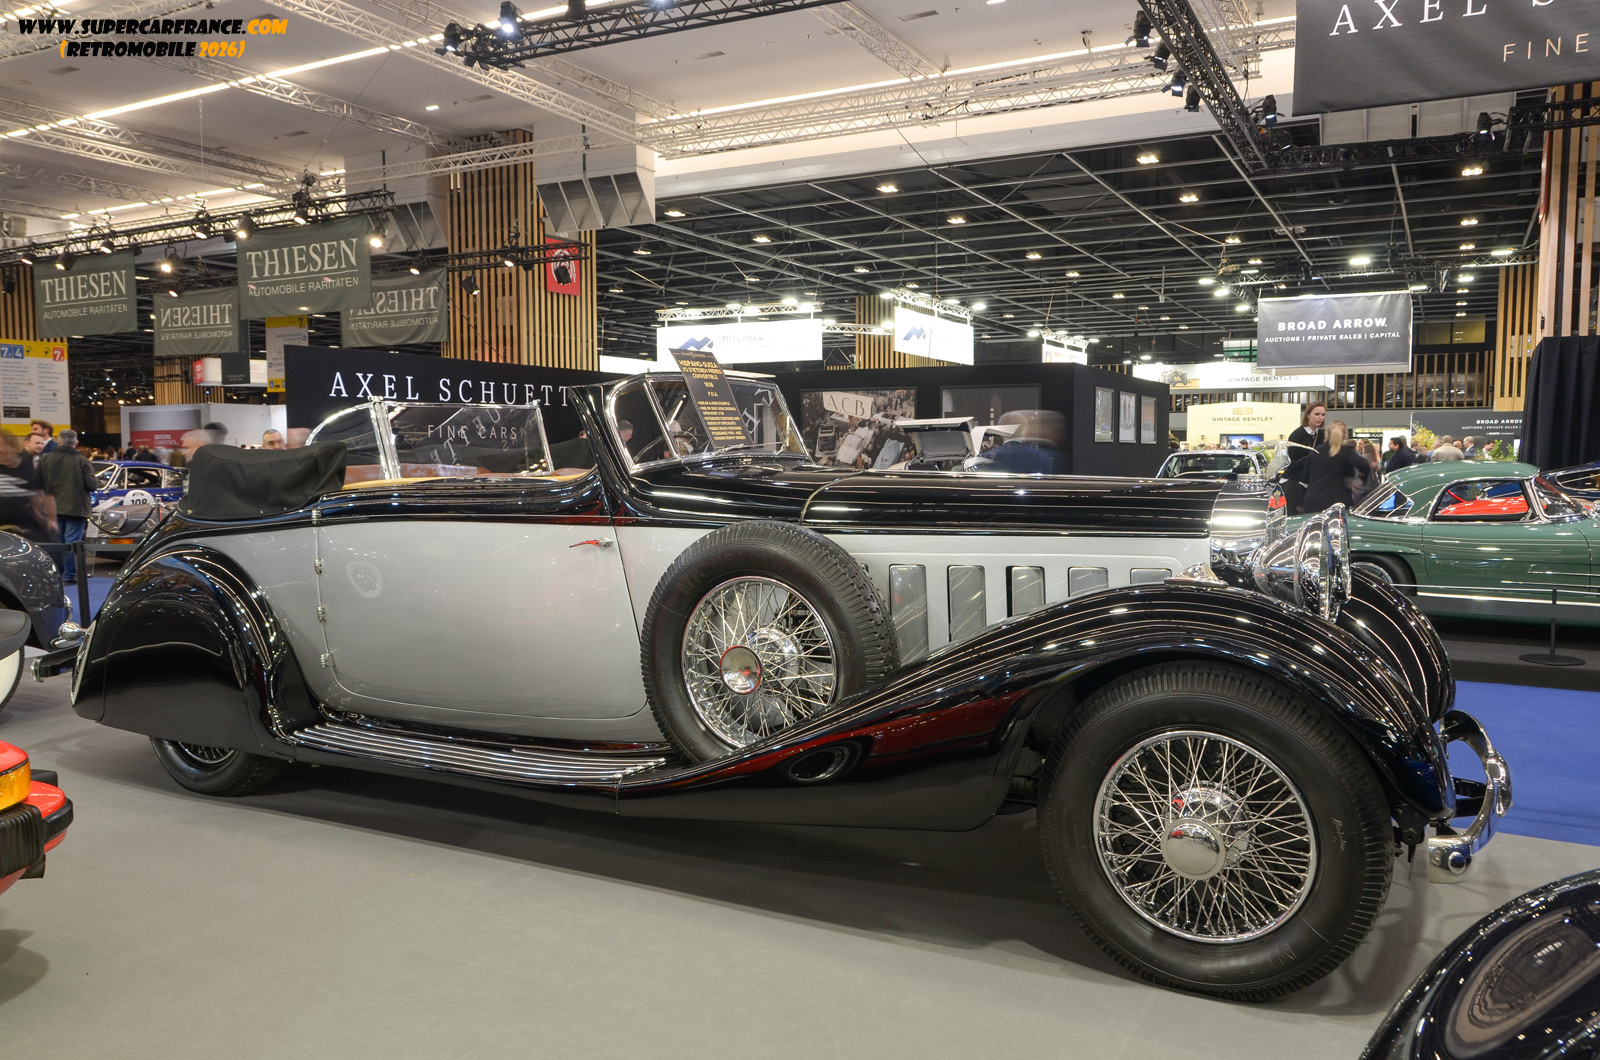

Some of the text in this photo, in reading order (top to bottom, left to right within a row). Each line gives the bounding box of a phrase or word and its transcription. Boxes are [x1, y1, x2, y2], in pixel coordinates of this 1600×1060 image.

[1329, 0, 1487, 36] AXEL
[1503, 33, 1590, 62] FINE
[246, 238, 358, 279] THIESEN
[41, 270, 126, 304] THIESEN
[248, 277, 359, 297] AUTOMOBILE RARITÄTEN
[43, 304, 128, 320] AUTOMOBILE RARITÄTEN
[1277, 320, 1327, 331] BROAD
[722, 334, 764, 342] MITCHELL
[678, 360, 718, 369] HISPANO-SUIZA
[329, 371, 420, 400] AXEL
[427, 424, 467, 439] FINE
[479, 426, 518, 440] CARS
